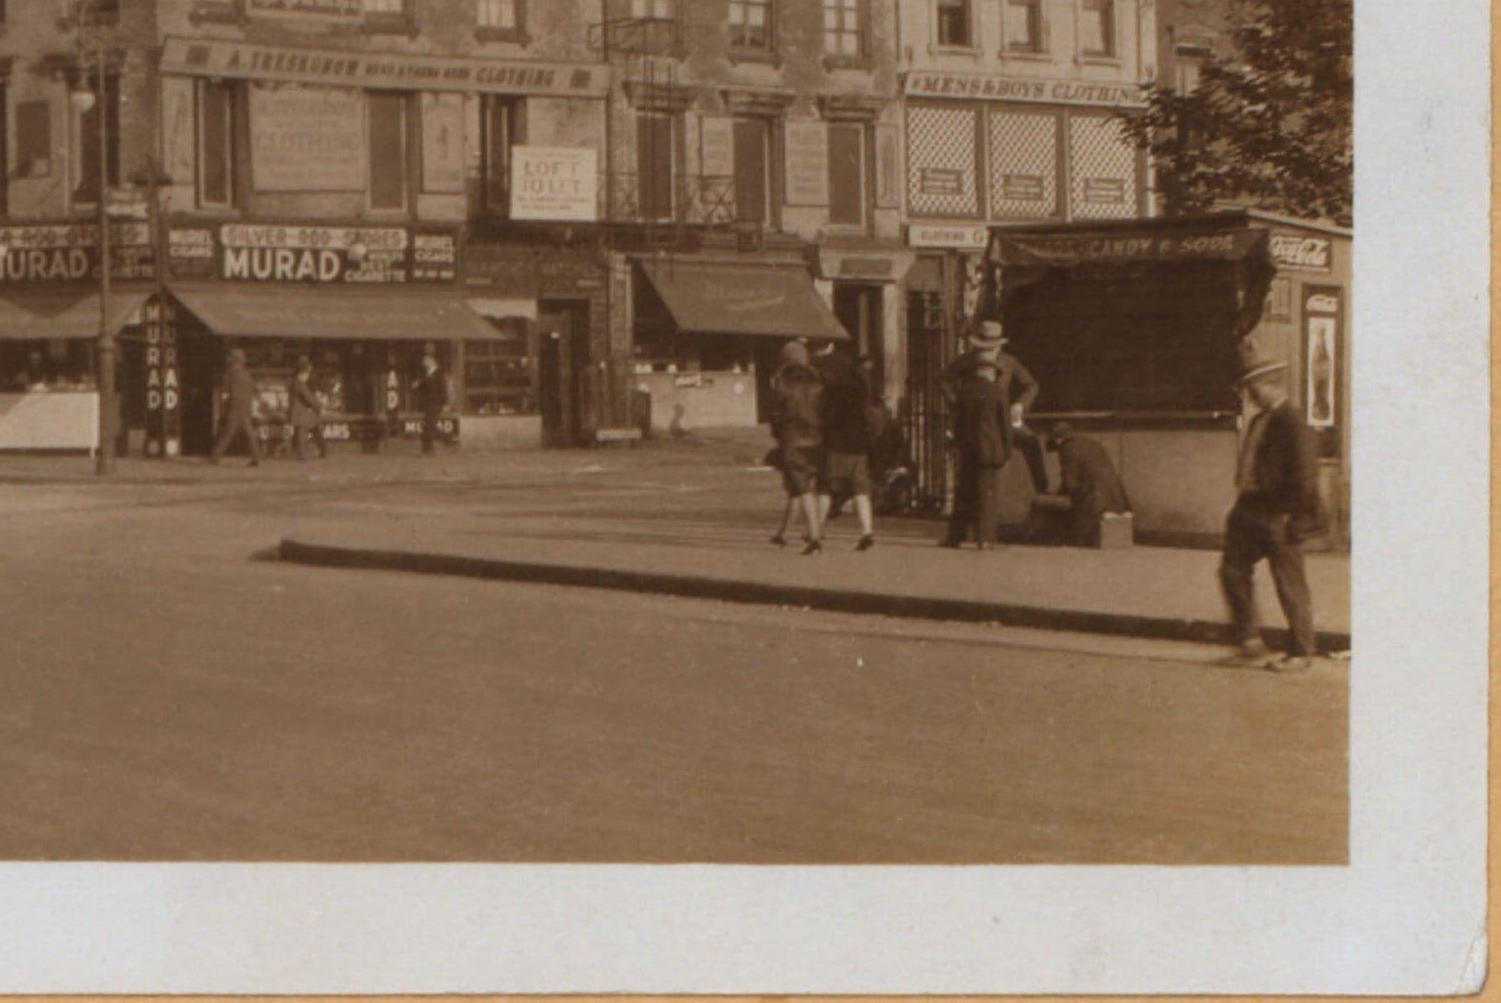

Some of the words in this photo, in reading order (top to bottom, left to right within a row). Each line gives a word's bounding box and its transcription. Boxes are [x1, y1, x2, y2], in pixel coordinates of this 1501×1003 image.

[476, 67, 555, 86] CLOTHING
[523, 160, 580, 177] LOFT
[522, 179, 545, 194] TO
[548, 179, 582, 195] LET
[227, 226, 286, 244] SILVER
[299, 228, 331, 246] ROD
[223, 246, 342, 281] MURAD
[146, 304, 161, 410] MURAD
[163, 304, 178, 410] MURAD
